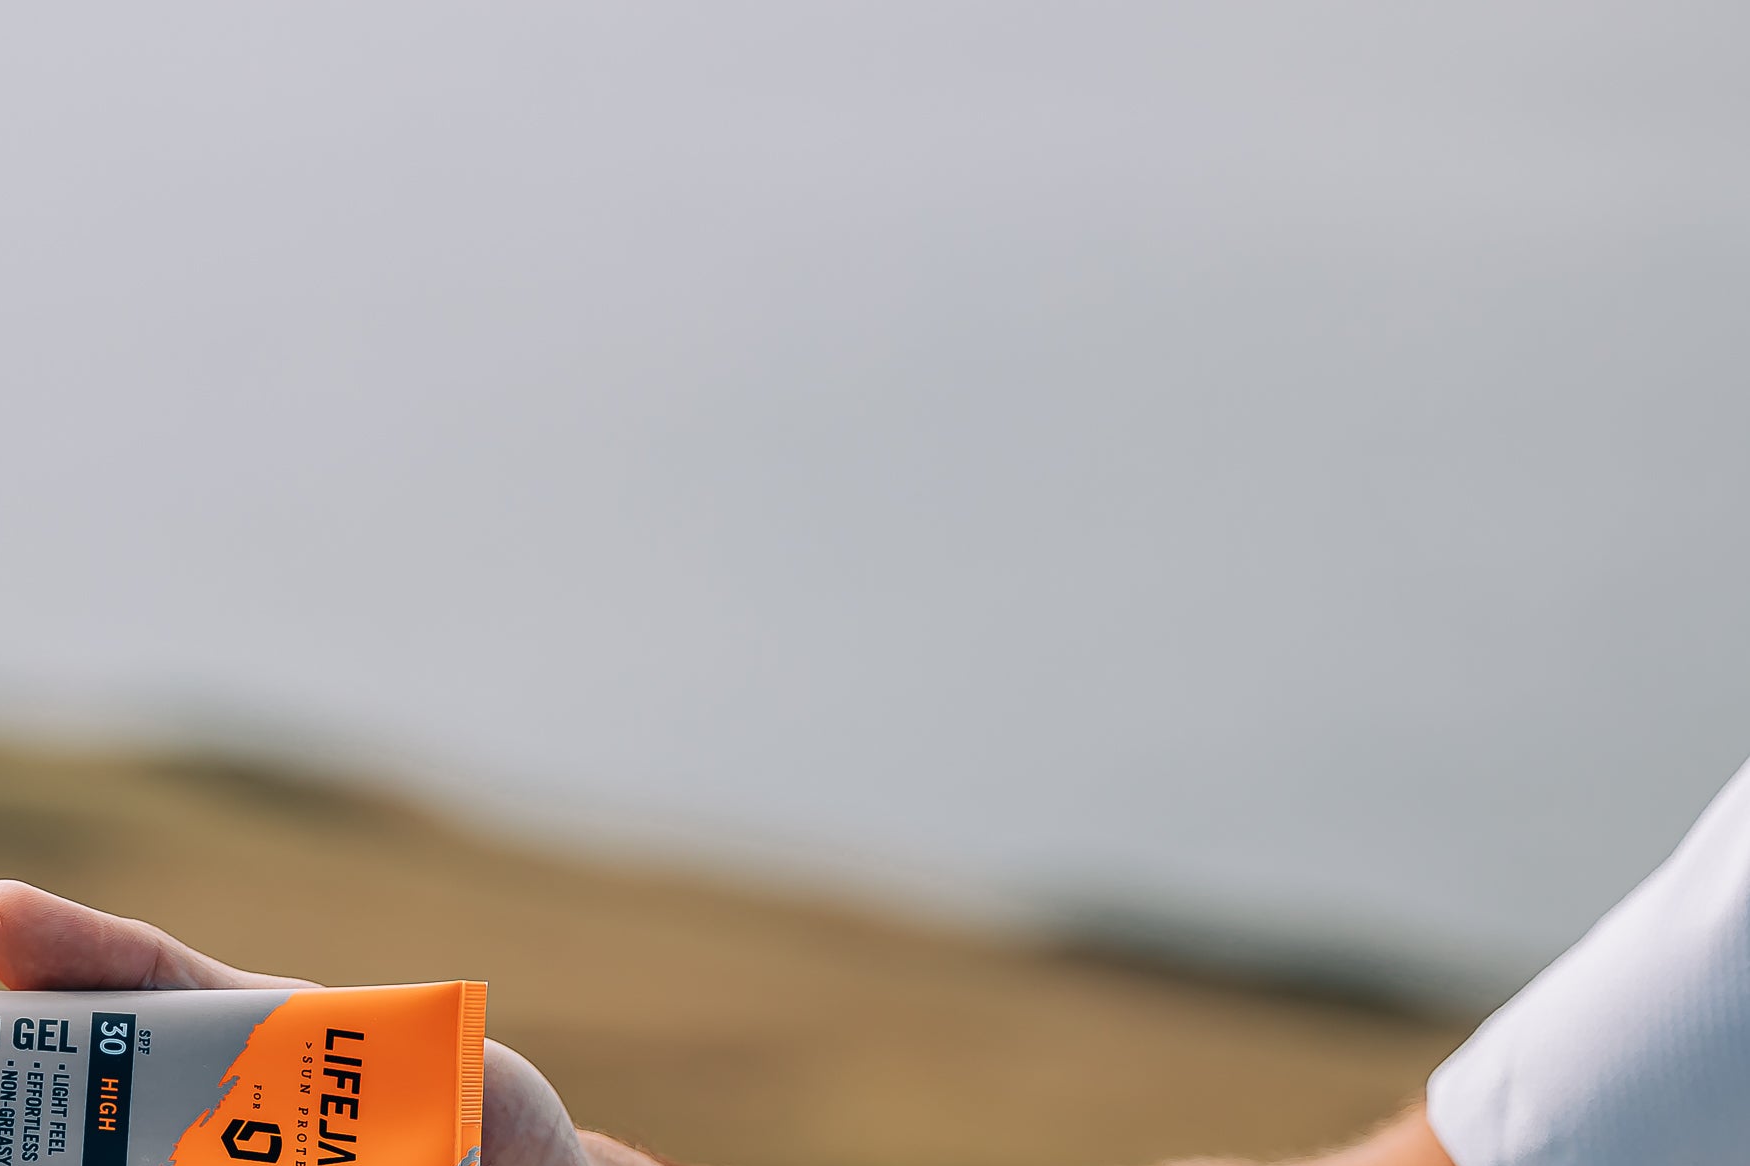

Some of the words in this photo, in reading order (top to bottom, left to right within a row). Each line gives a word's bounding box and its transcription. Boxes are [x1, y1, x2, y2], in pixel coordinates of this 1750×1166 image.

[12, 1017, 78, 1054] GEL
[100, 1021, 128, 1055] 30
[138, 1029, 151, 1055] SPF
[299, 1055, 313, 1094] SUN
[50, 1073, 70, 1118] LIGHT
[98, 1077, 119, 1131] HIGH
[252, 1084, 263, 1110] FOR
[21, 1071, 44, 1163] EFFORTLESS
[48, 1120, 67, 1156] FEEL
